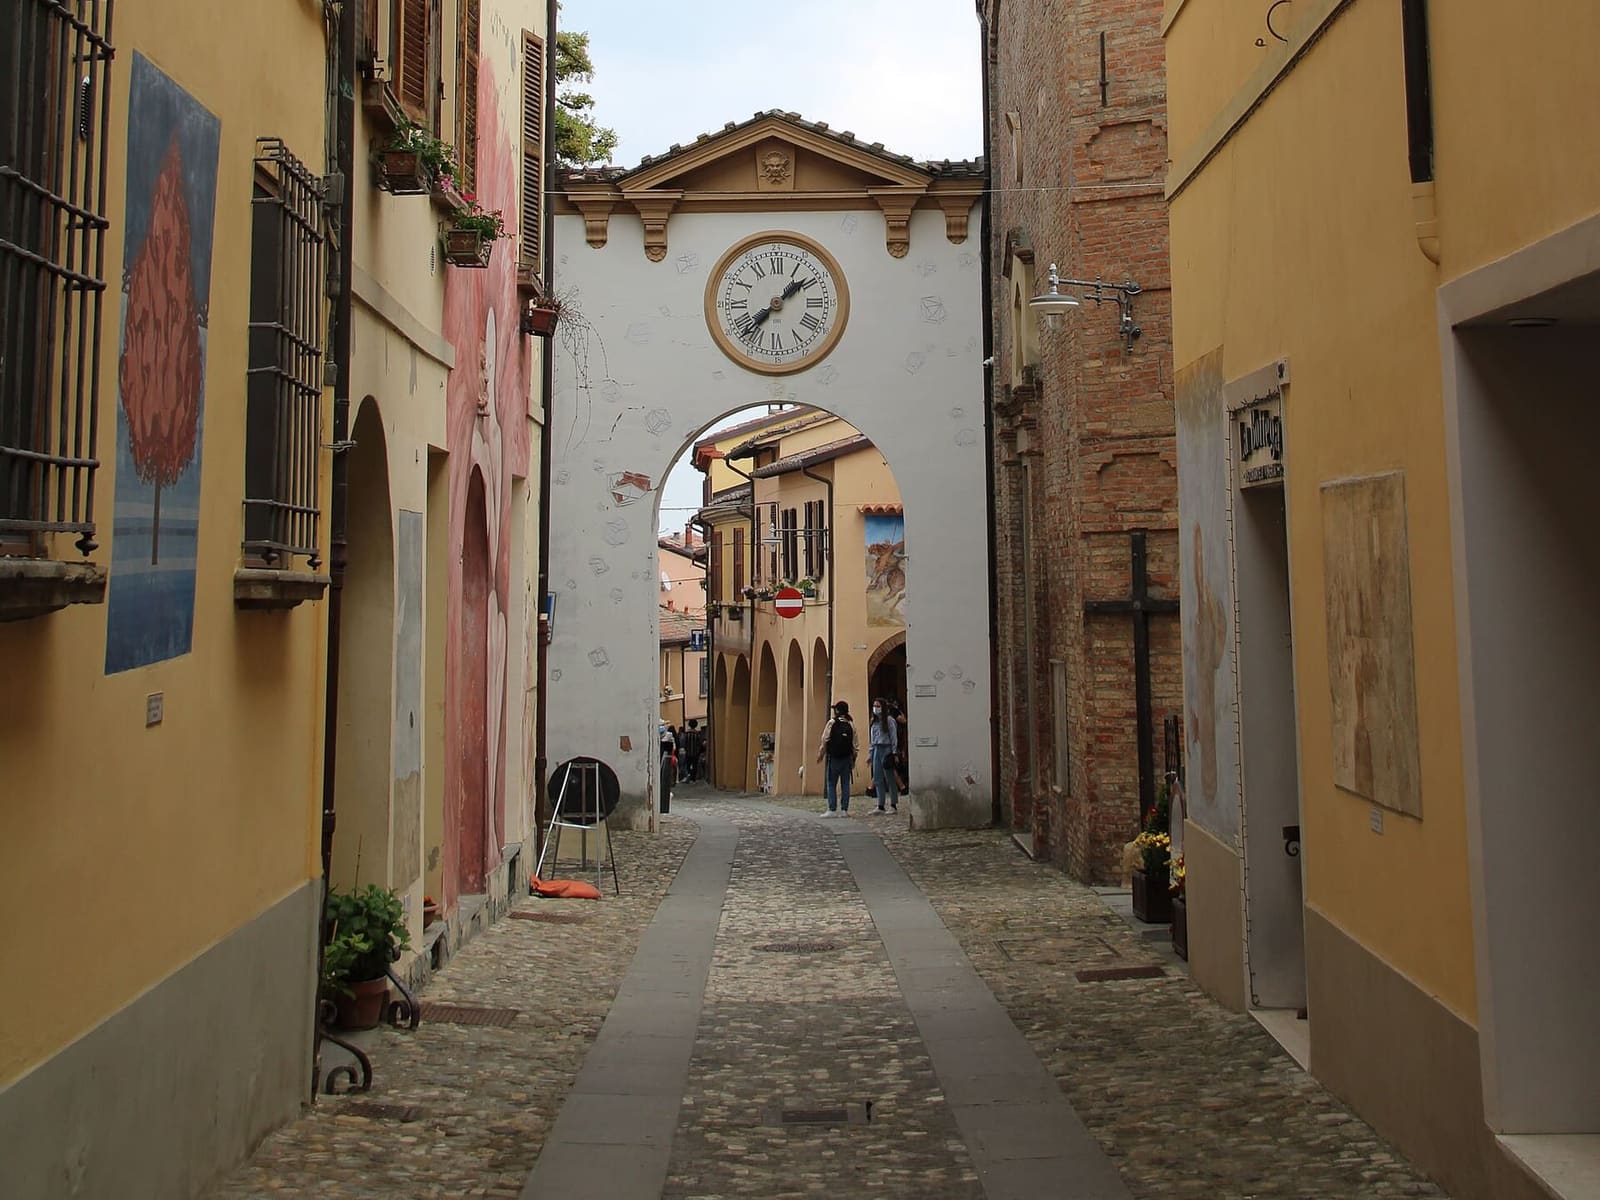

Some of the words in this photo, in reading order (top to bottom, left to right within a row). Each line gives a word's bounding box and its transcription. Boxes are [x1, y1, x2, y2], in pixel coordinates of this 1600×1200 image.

[750, 261, 766, 281] XI
[770, 257, 784, 275] XII
[791, 263, 800, 278] I
[735, 279, 752, 293] X
[801, 277, 817, 290] II
[731, 299, 747, 309] IX
[806, 297, 823, 309] III
[749, 326, 765, 347] VII
[771, 332, 783, 350] VI
[791, 329, 804, 345] V
